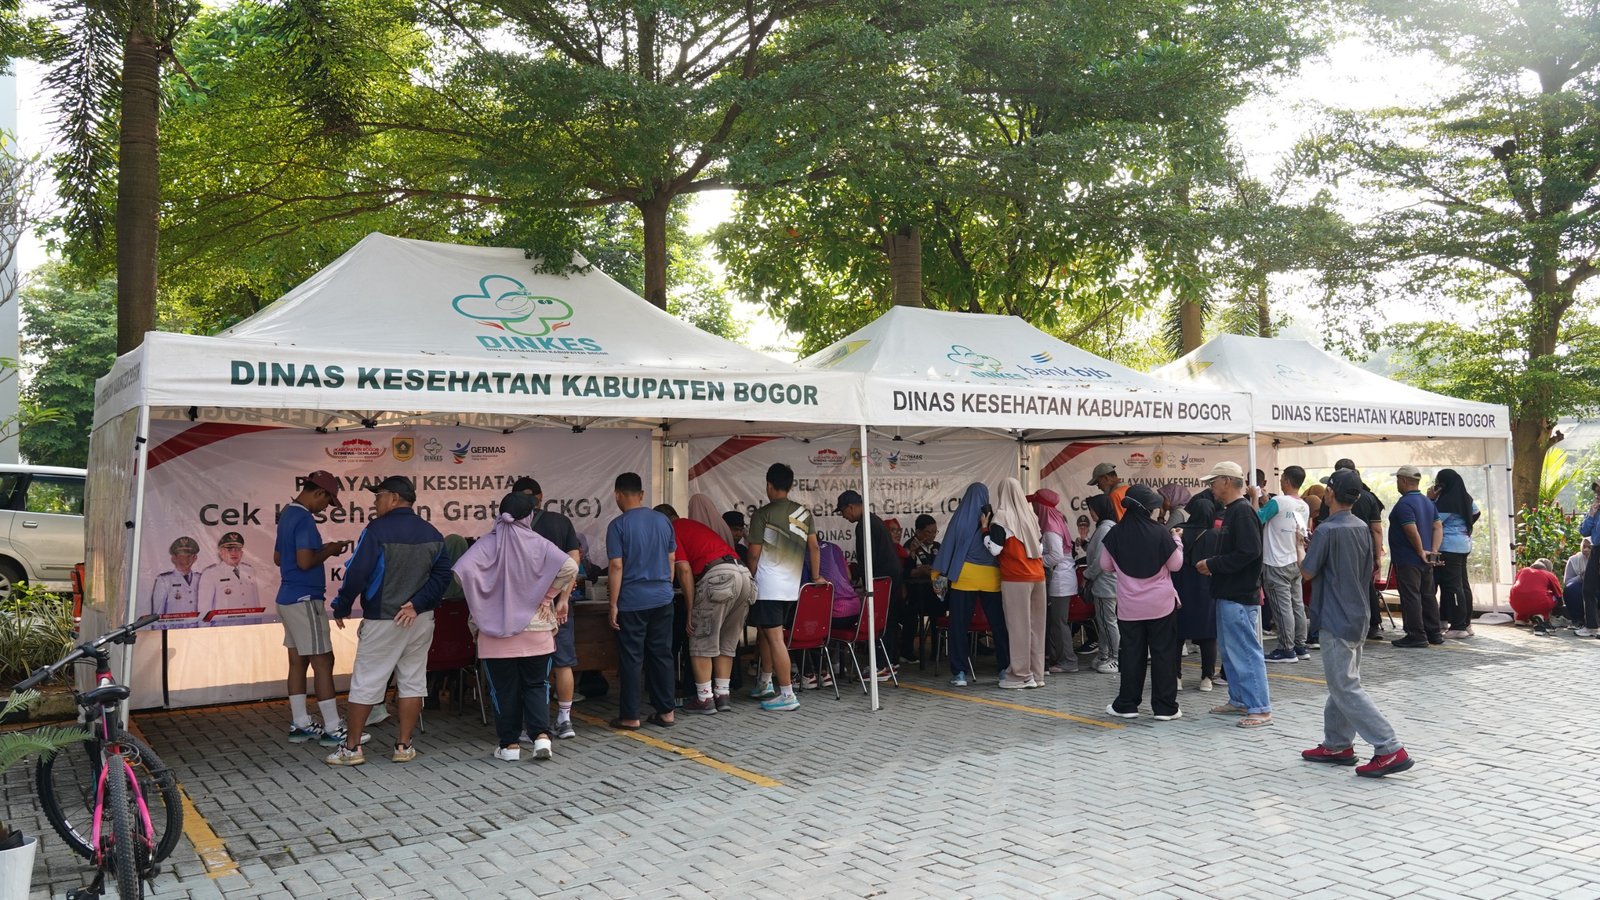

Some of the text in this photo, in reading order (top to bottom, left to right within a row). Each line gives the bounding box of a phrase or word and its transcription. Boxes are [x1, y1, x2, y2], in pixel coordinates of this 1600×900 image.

[475, 335, 602, 351] DINKES
[1017, 364, 1113, 380] bank bjb
[230, 360, 818, 405] DINAS KESEHATAN KABUPATEN BOGOR
[893, 390, 1232, 421] DINAS KESEHATAN KABUPATEN BOGOR
[1271, 404, 1496, 428] DINAS KESEHATAN KABUPATEN BOGOR
[470, 446, 506, 454] GERMAS
[199, 503, 261, 526] Cek
[443, 500, 500, 521] Grat
[544, 497, 602, 519] CKG)
[883, 496, 933, 515] Gratis
[1071, 496, 1088, 511] Ce
